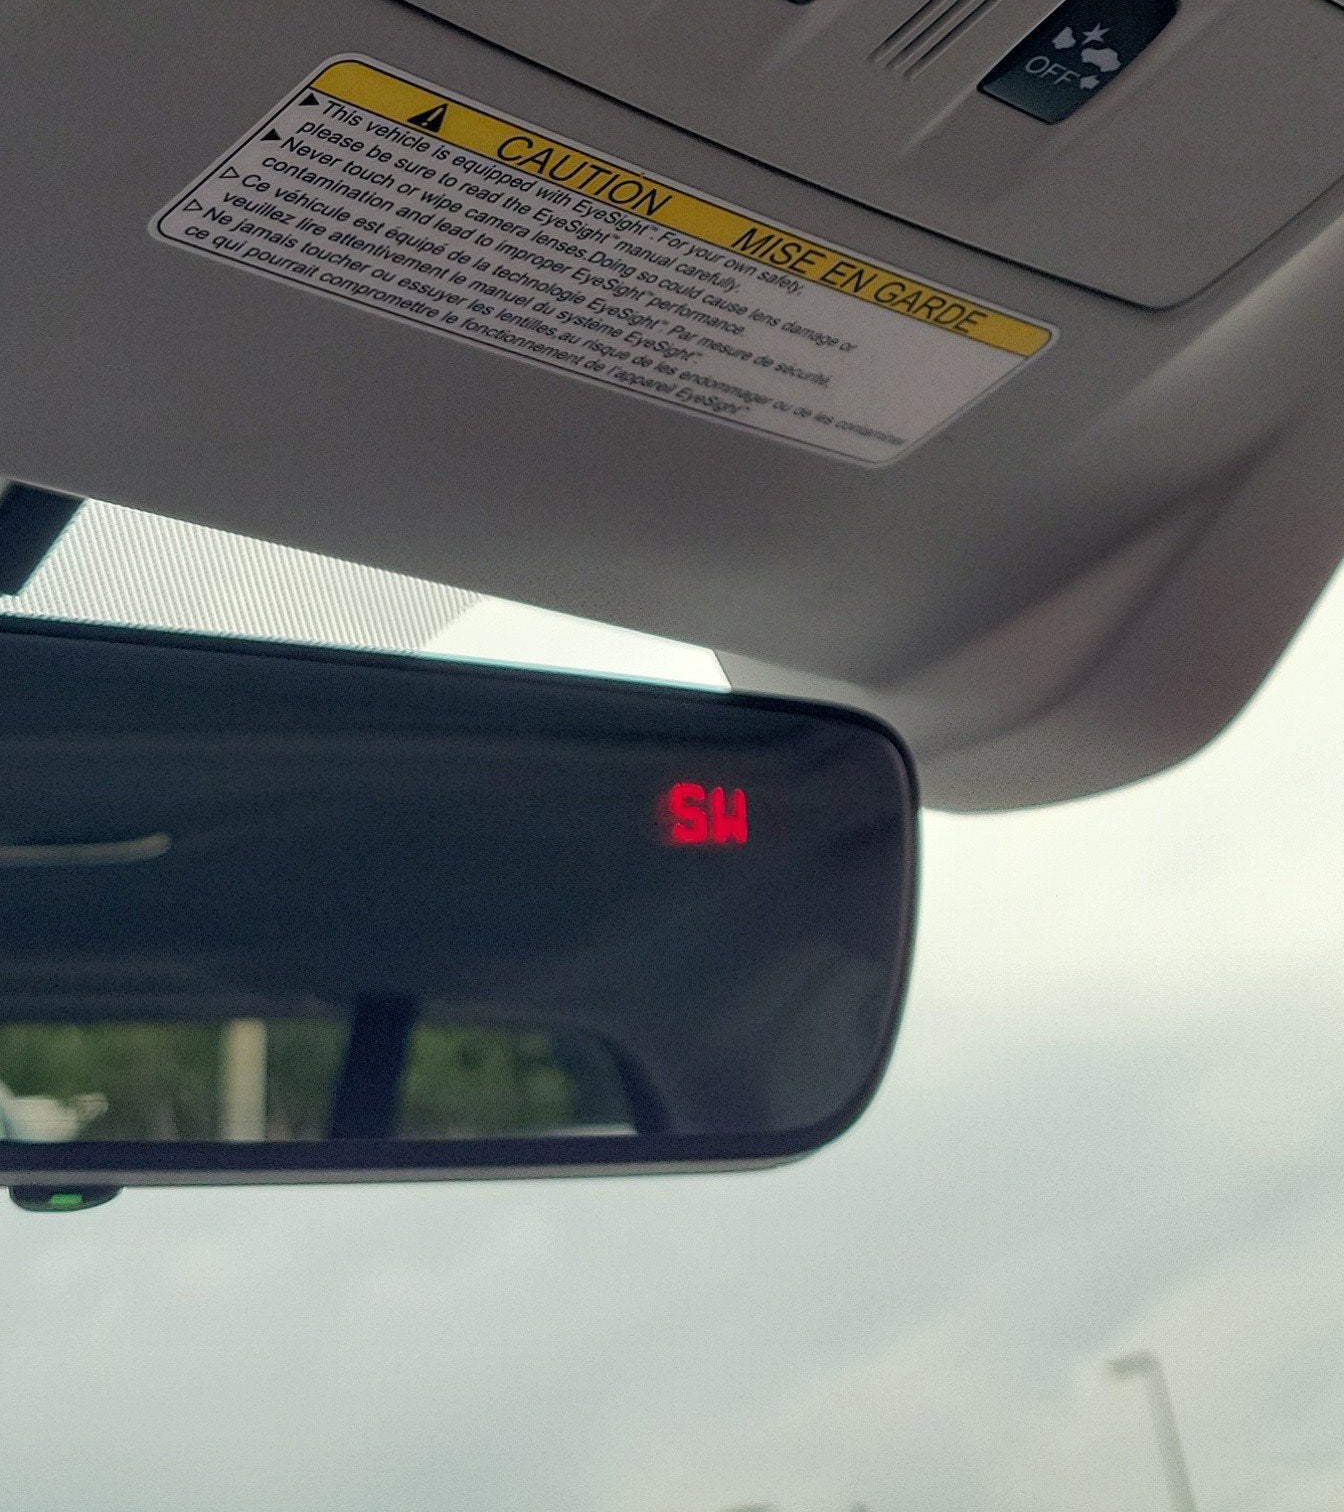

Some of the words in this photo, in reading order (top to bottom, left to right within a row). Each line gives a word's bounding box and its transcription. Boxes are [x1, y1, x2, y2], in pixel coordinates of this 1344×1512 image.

[1024, 54, 1080, 87] OFF
[261, 157, 395, 212] contamination
[394, 206, 436, 226] and
[432, 217, 478, 240] lead
[473, 233, 494, 247] to
[493, 239, 573, 274] improper
[279, 136, 344, 167] Never
[341, 160, 396, 189] touch
[396, 183, 421, 196] or
[420, 191, 463, 213] wipe
[464, 208, 531, 238] camera
[636, 271, 659, 284] so
[657, 278, 706, 300] could
[701, 294, 749, 316] cause
[747, 308, 782, 327] lens
[780, 321, 840, 347] damage
[838, 342, 859, 353] or
[295, 121, 365, 153] please
[365, 144, 393, 163] be
[393, 158, 437, 180] sure
[437, 172, 459, 188] to
[457, 182, 506, 204] read
[501, 196, 532, 215] the
[613, 240, 679, 268] manual
[322, 100, 364, 127] This
[365, 121, 431, 153] vehicle
[430, 144, 451, 161] is
[451, 155, 539, 193] equipped
[535, 187, 572, 207] with
[656, 231, 690, 250] For
[682, 244, 726, 263] your
[723, 258, 758, 277] own
[496, 136, 673, 216] CAUTION
[183, 225, 211, 240] ce
[211, 235, 248, 252] qui
[241, 246, 320, 278] pourrait
[318, 272, 440, 318] compromettre
[439, 310, 460, 325] le
[459, 317, 586, 366] fonctionnement
[582, 359, 606, 372] de
[201, 206, 233, 226] Ne
[228, 218, 299, 249] jamais
[299, 241, 372, 273] toucher
[370, 268, 397, 283] ou
[396, 277, 469, 306] essuyer
[466, 298, 495, 316] les
[581, 339, 632, 361] risque
[630, 355, 654, 368] de
[653, 360, 679, 376] les
[222, 192, 296, 225] veuillez
[294, 217, 327, 236] lire
[327, 231, 451, 279] attentivement
[448, 271, 468, 285] le
[467, 280, 536, 308] manuel
[531, 301, 557, 316] du
[555, 310, 624, 338] système
[241, 174, 271, 193] Ce
[274, 187, 351, 222] véhicule
[352, 217, 386, 234] est
[384, 226, 449, 256] équipé
[446, 250, 472, 265] de
[471, 257, 492, 272] la
[491, 264, 587, 305] technologie
[666, 324, 699, 342] Par
[696, 336, 754, 361] mesure
[752, 355, 775, 368] de
[730, 227, 827, 275] MISE
[819, 260, 878, 294] EN
[873, 281, 989, 336] GARDE
[669, 783, 748, 844] SW
